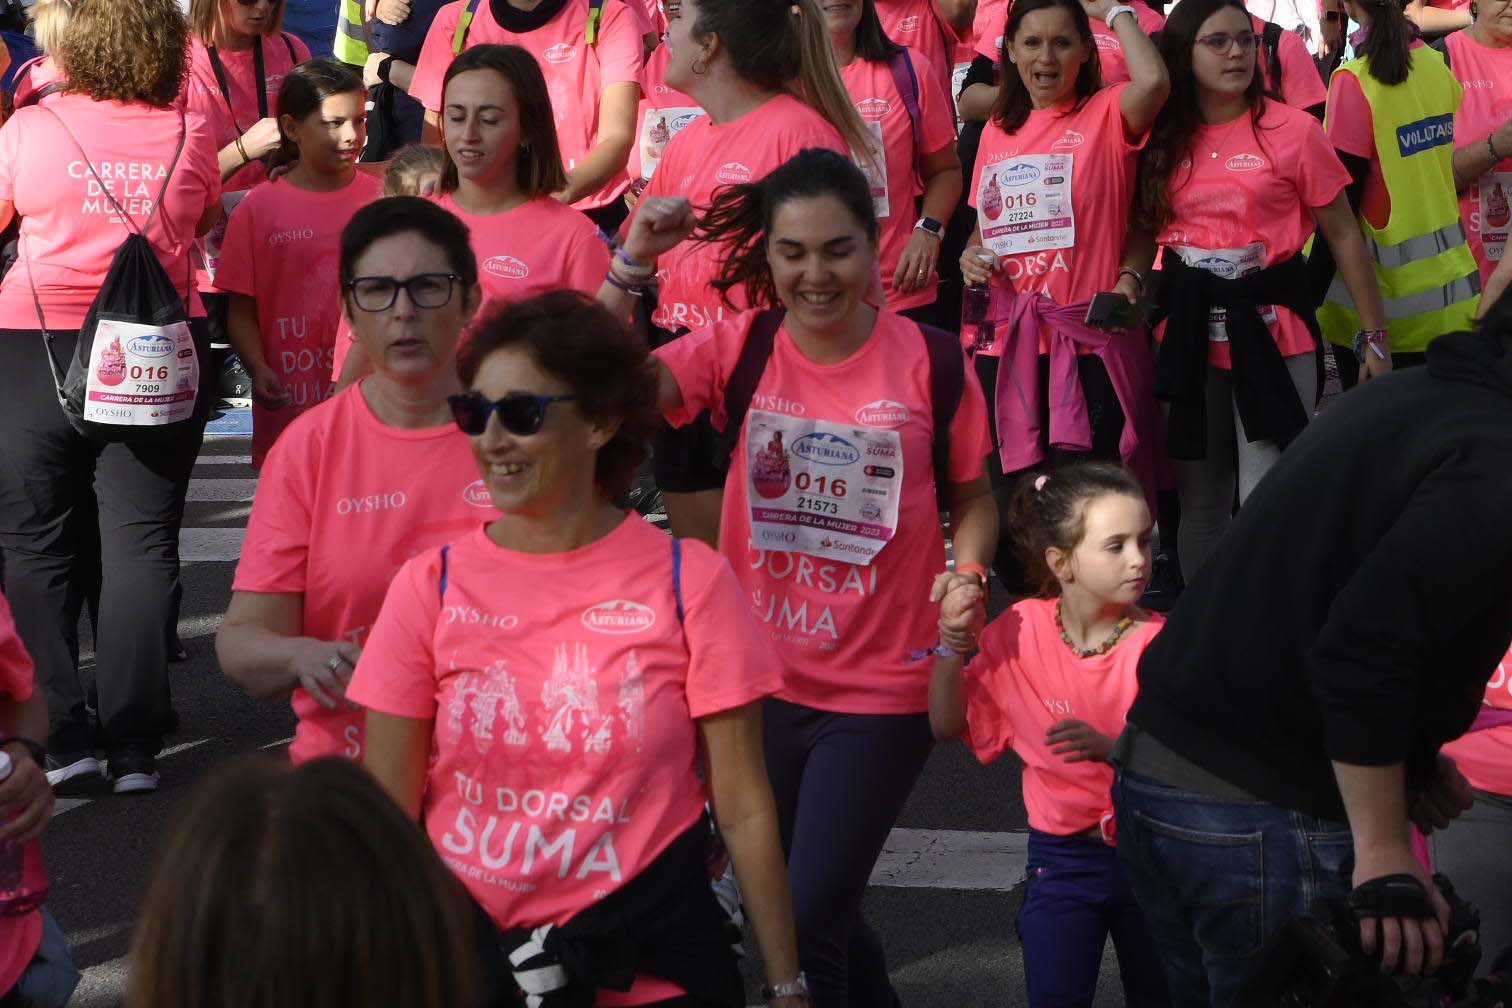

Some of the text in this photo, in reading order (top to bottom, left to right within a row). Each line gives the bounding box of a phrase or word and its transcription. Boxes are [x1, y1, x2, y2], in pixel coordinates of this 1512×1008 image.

[67, 160, 169, 180] CARRERA
[87, 179, 150, 197] DE LA
[81, 198, 154, 216] MUJER
[1005, 192, 1037, 209] 016
[1009, 211, 1034, 222] 27224
[269, 228, 314, 247] OYSHO
[486, 260, 528, 278] ASTURIANA
[276, 317, 308, 338] TU
[131, 342, 172, 352] ASTURIANA
[130, 365, 169, 380] 016
[135, 384, 160, 393] 7909
[101, 394, 133, 403] CARRERA
[144, 395, 153, 403] LA
[96, 407, 132, 418] OYSHO
[858, 410, 908, 423] ASTURIANA
[796, 441, 854, 462] ASTURIANA
[865, 447, 896, 458] SUMA
[795, 472, 848, 498] 016
[336, 492, 407, 516] OYSHO
[796, 496, 838, 515] 21573
[799, 513, 811, 524] DE
[813, 515, 825, 526] LA
[826, 517, 857, 533] MUJER
[588, 609, 651, 627] ASTURIANA
[453, 772, 631, 825] TU DORSAL
[442, 807, 623, 882] SUMA
